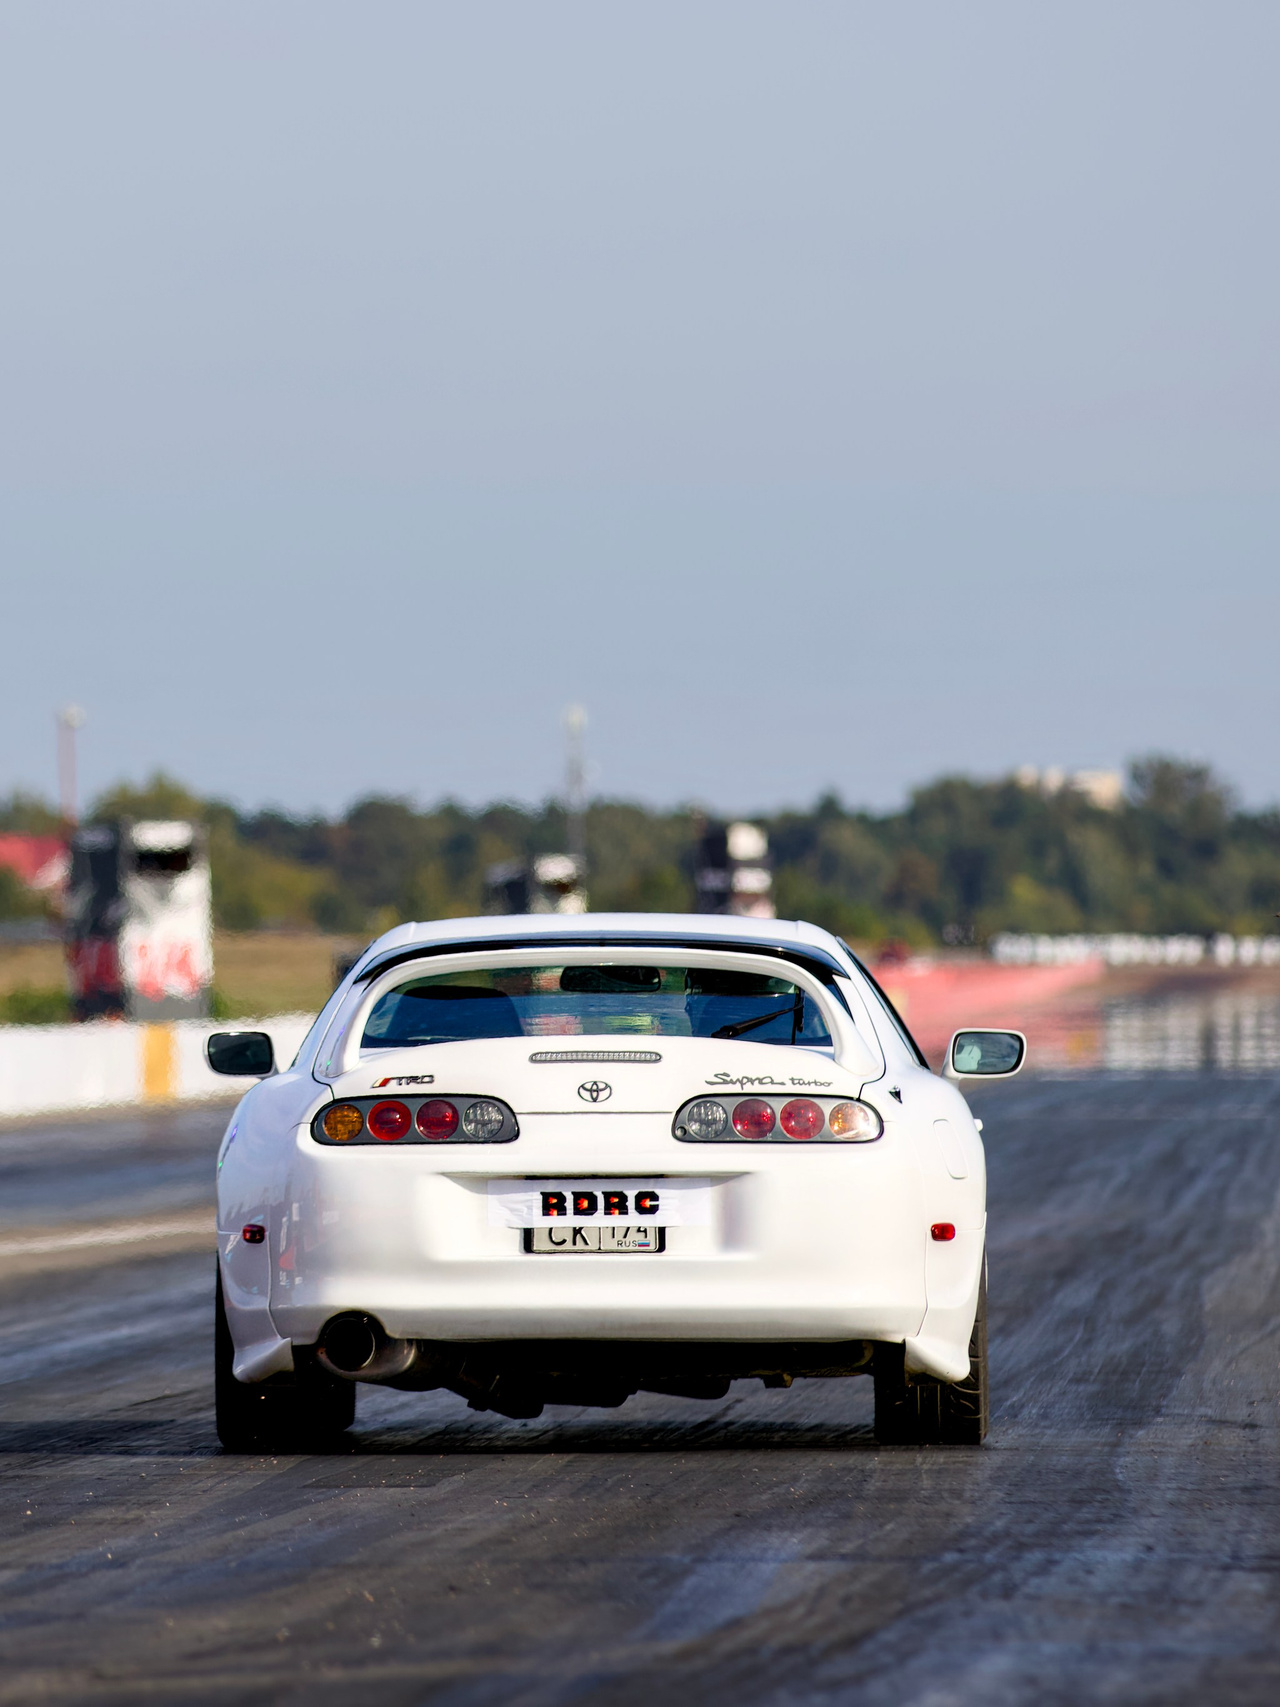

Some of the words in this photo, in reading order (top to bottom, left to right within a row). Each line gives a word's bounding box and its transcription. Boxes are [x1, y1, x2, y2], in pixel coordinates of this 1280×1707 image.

[387, 1074, 435, 1086] TRD
[705, 1072, 787, 1090] Supra
[788, 1077, 833, 1088] turbo
[540, 1190, 660, 1216] RDRC
[616, 1239, 638, 1248] RUS
